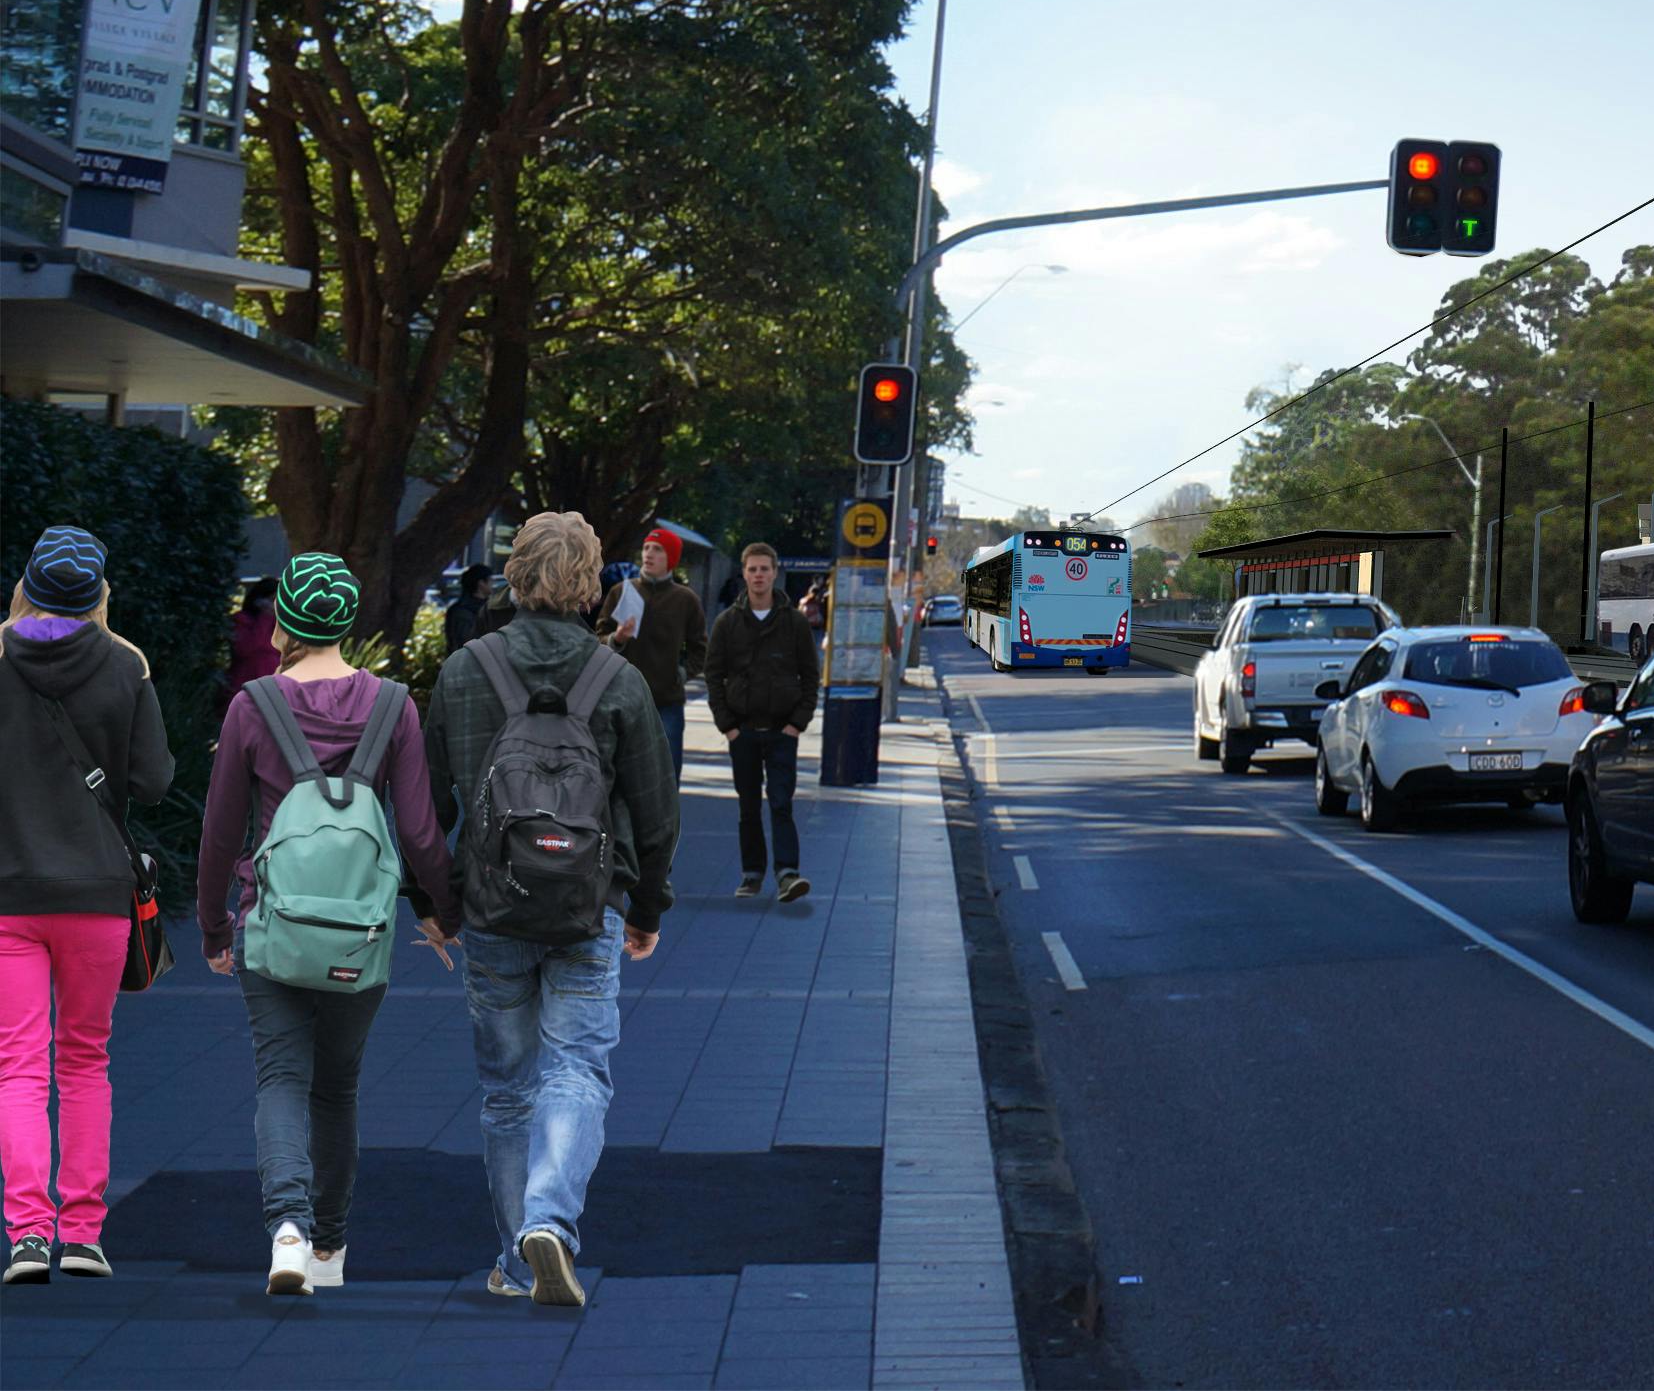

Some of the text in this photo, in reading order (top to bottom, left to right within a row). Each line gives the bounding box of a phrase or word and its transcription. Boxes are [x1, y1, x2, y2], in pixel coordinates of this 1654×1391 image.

[1066, 537, 1087, 551] 054
[1069, 561, 1084, 575] 40
[536, 838, 569, 848] EASTPAK
